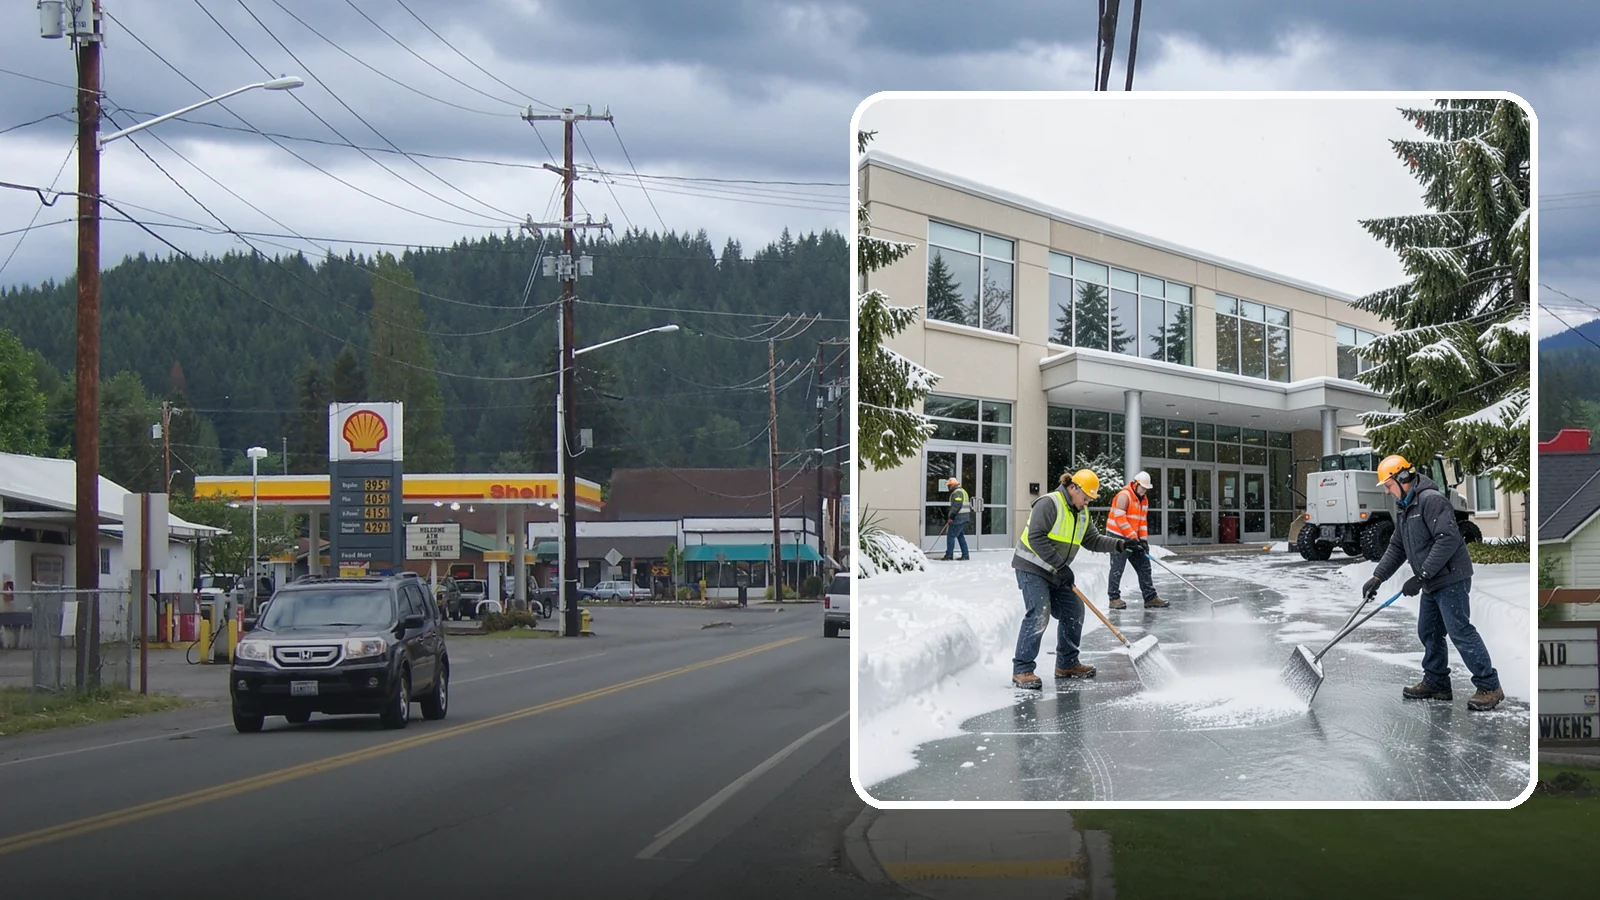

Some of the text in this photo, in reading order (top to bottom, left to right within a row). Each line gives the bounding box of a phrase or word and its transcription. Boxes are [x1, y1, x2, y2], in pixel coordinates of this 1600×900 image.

[365, 480, 384, 490] 395
[490, 484, 547, 499] Shell
[365, 494, 384, 504] 405
[365, 508, 384, 518] 415
[365, 522, 384, 533] 429
